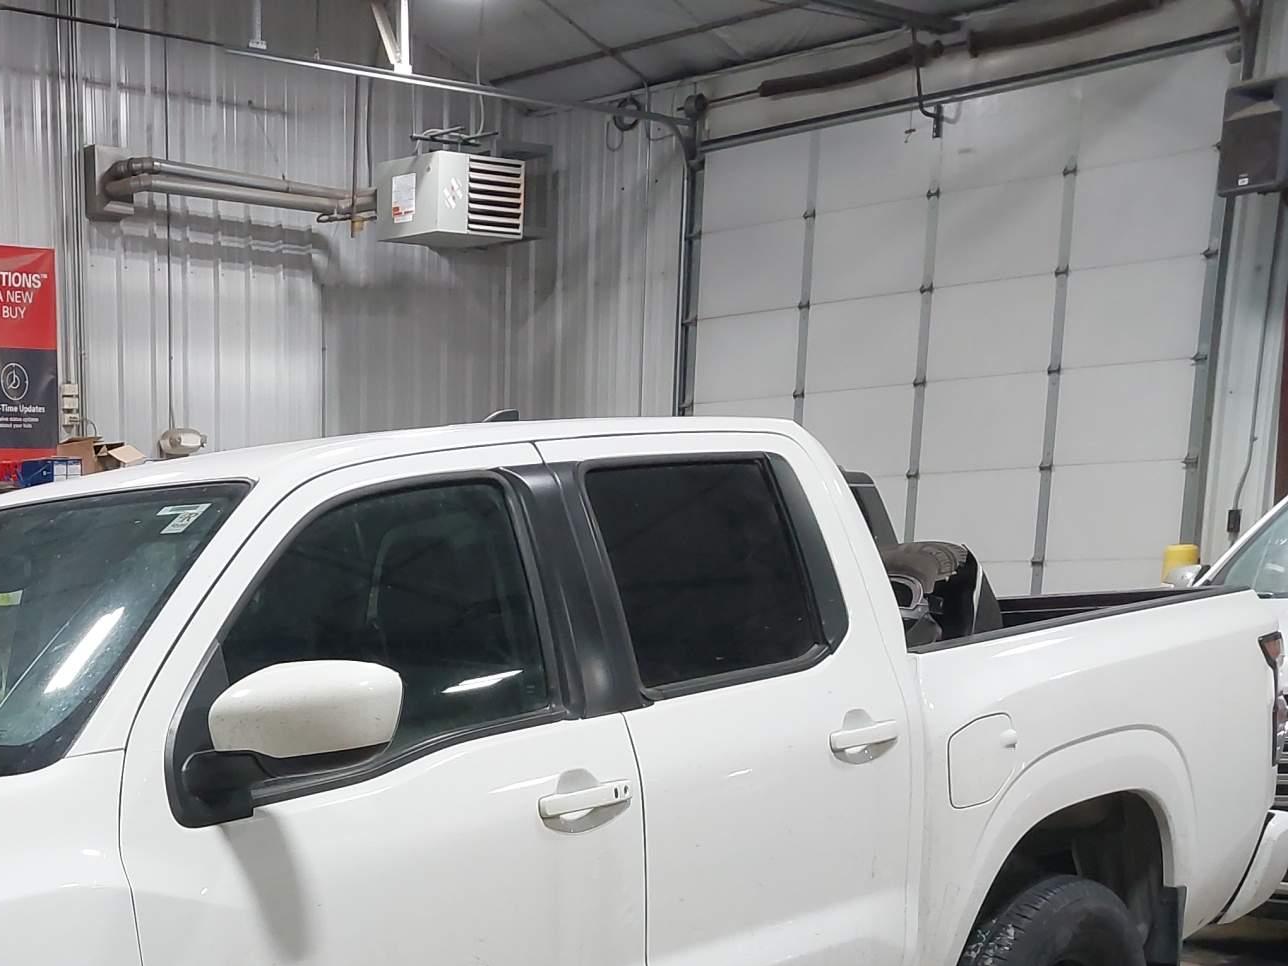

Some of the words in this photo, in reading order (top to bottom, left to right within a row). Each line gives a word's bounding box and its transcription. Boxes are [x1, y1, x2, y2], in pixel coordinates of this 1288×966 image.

[6, 290, 34, 304] NEW
[2, 306, 27, 319] BUY
[19, 404, 45, 414] Updates
